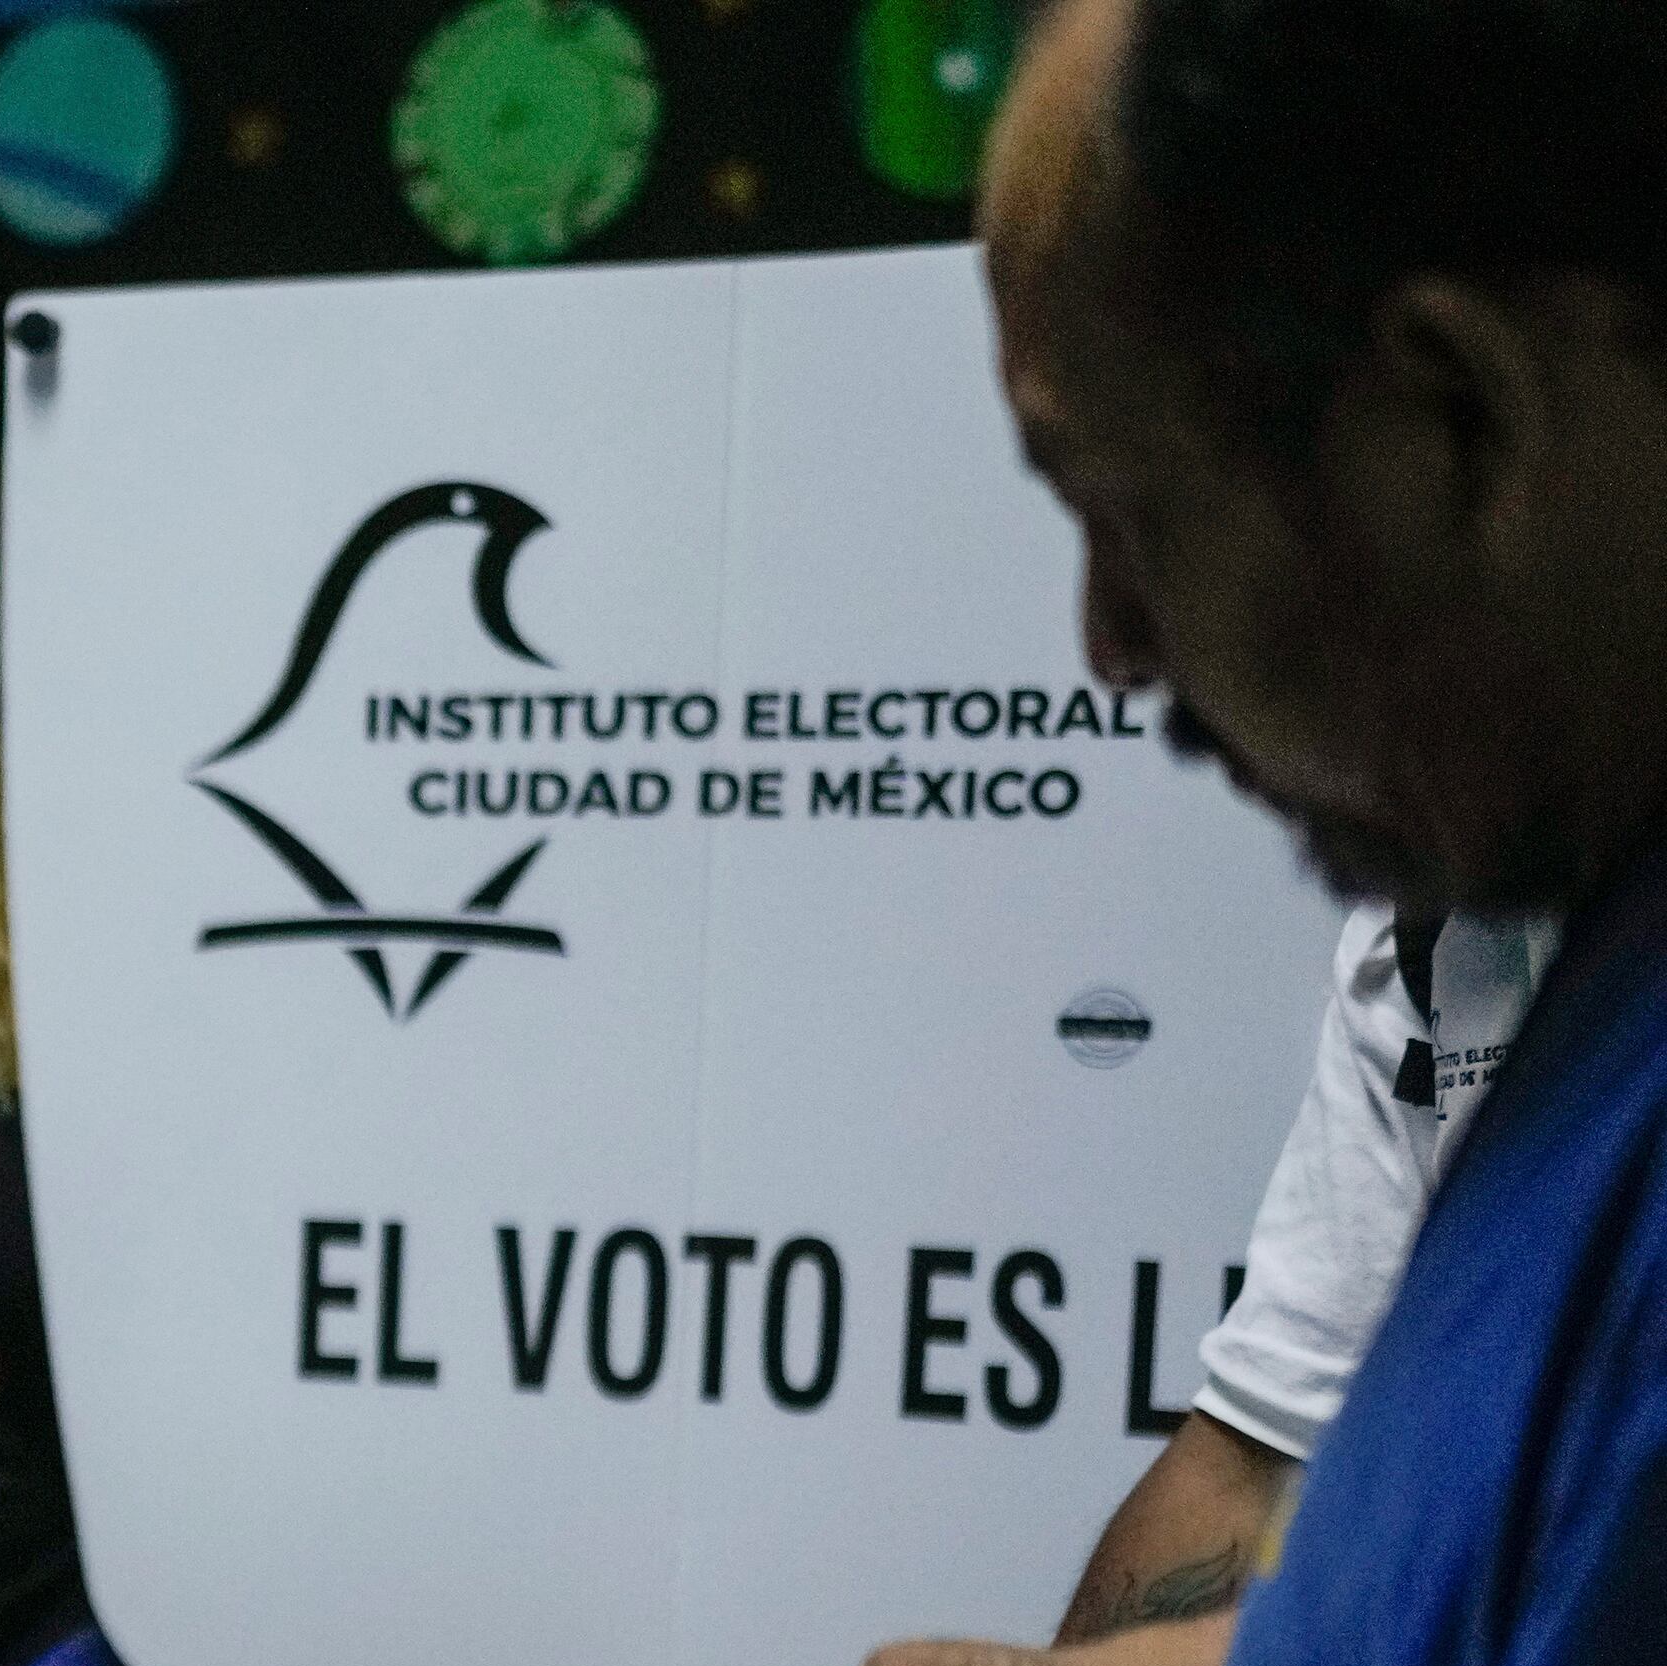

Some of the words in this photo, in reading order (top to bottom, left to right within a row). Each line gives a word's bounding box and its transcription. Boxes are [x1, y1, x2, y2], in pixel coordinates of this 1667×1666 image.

[365, 691, 720, 742] INSTITUTO
[742, 687, 1144, 741] ELECTORAL
[408, 768, 674, 818] CIUDAD
[697, 771, 785, 818] DE
[808, 754, 1081, 819] MÉXICO
[296, 1217, 439, 1388] EL
[494, 1226, 846, 1414] VOTO
[897, 1244, 1067, 1433] ES
[1123, 1257, 1248, 1439] L
